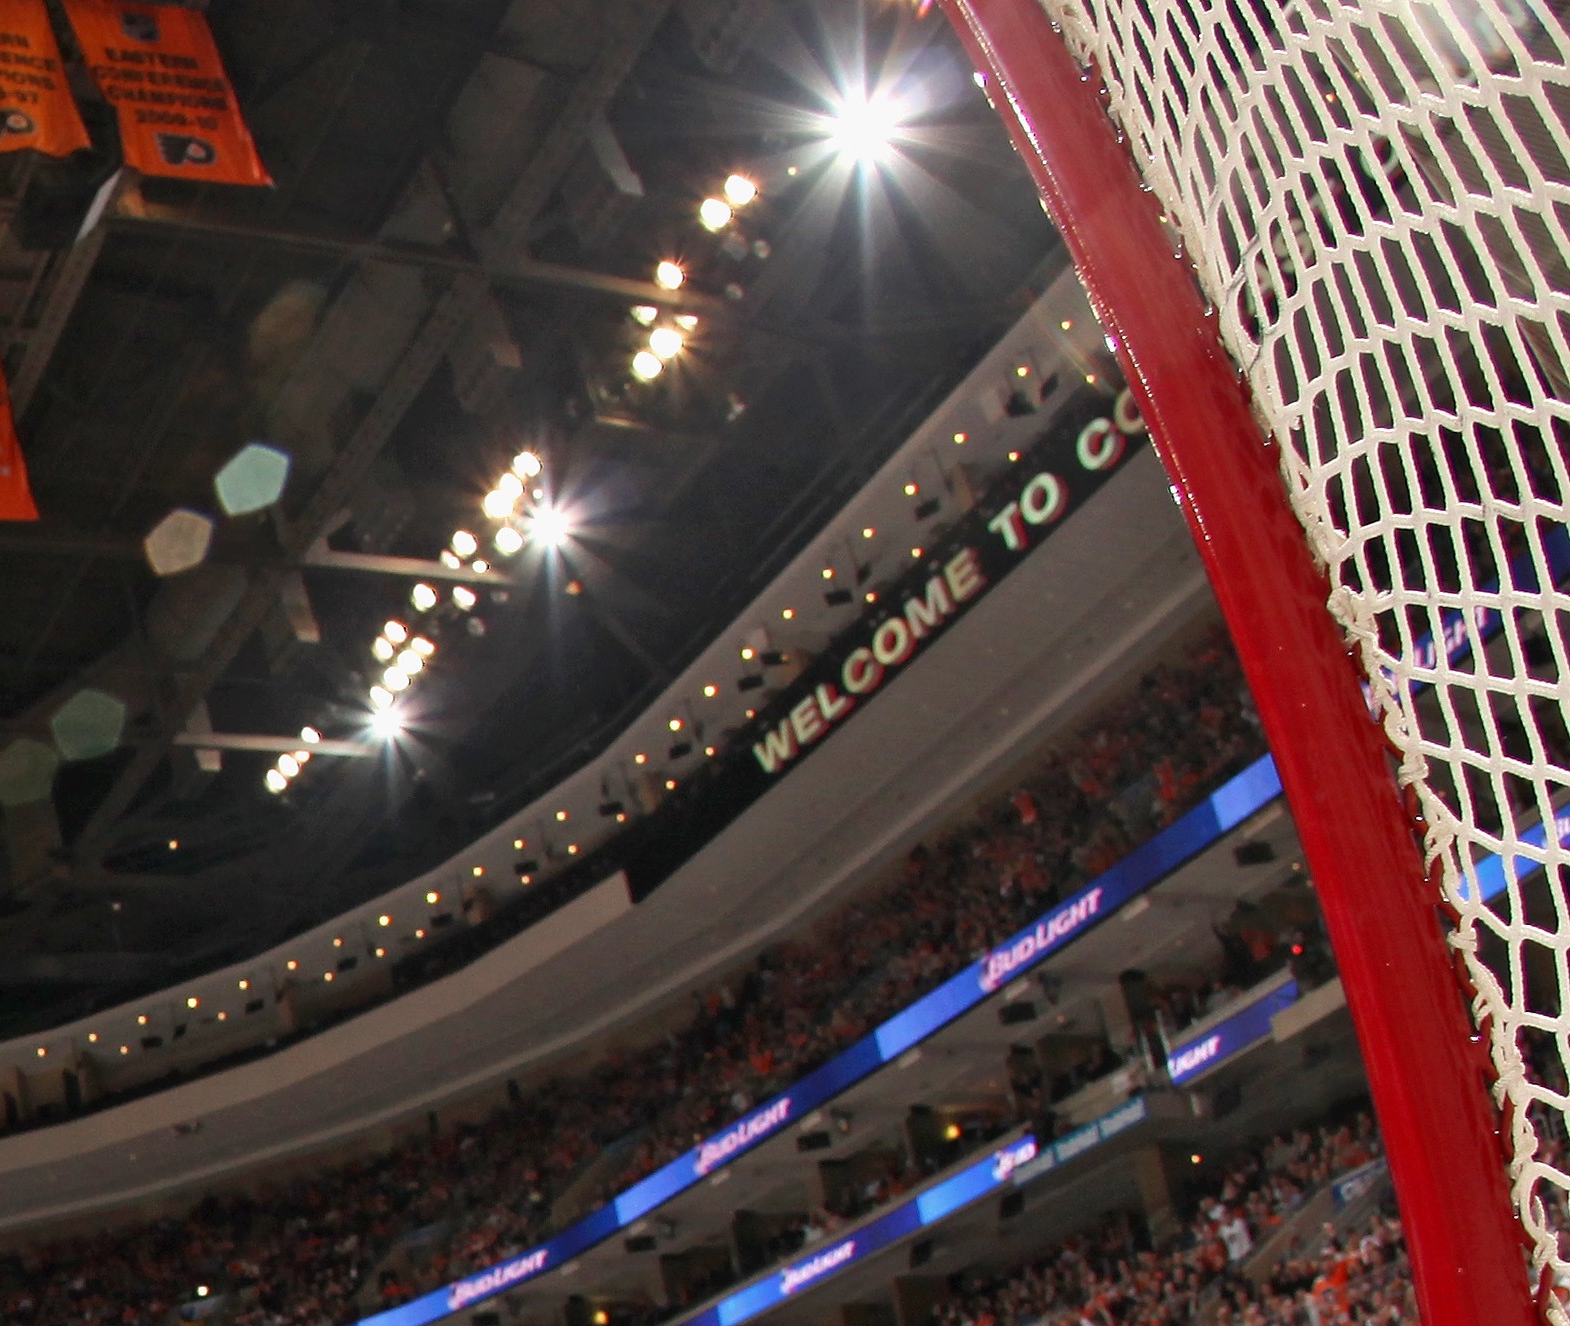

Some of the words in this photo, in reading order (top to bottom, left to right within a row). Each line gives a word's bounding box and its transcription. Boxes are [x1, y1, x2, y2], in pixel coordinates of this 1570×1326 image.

[752, 546, 987, 774] WELCOME
[988, 472, 1068, 551] TO
[1076, 387, 1146, 471] CO
[989, 934, 1037, 985] BUD
[1034, 889, 1104, 952] LIGHT
[737, 1097, 792, 1147] LIGHT
[491, 1249, 549, 1290] LIGHT
